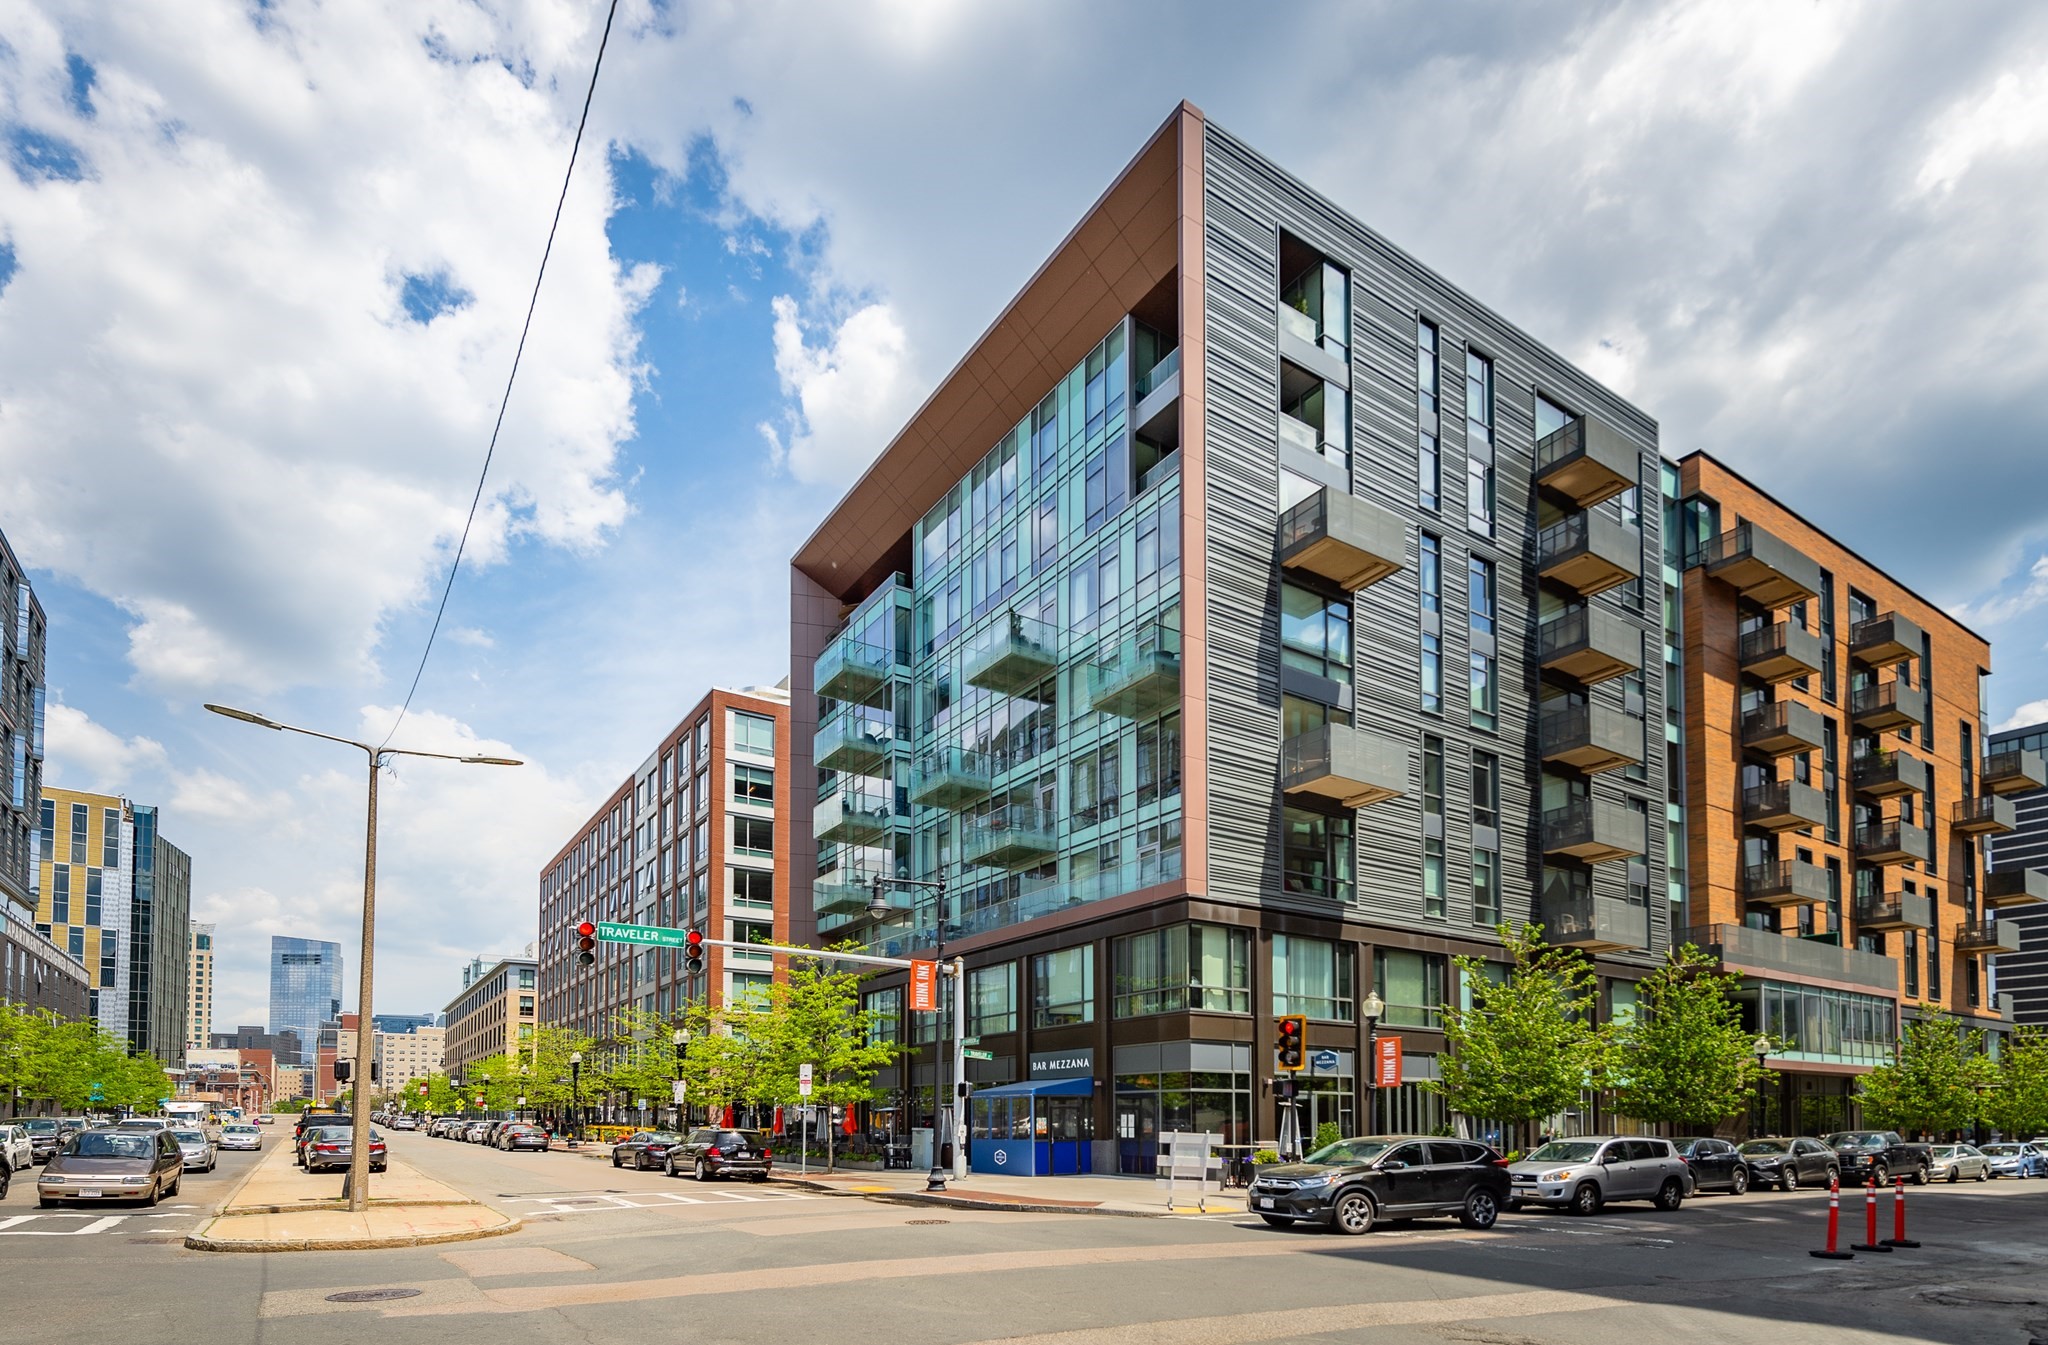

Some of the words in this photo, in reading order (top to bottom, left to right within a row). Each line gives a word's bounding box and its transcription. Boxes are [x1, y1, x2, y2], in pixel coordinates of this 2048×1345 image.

[6, 919, 43, 956] APARTMENTS
[600, 926, 659, 942] TRAVELER
[662, 936, 683, 944] STREET
[917, 964, 930, 980] INK
[916, 982, 929, 1008] THINK
[1383, 1041, 1396, 1057] INK
[1032, 1061, 1047, 1071] BAR
[1049, 1057, 1090, 1070] MEZZANA
[1383, 1058, 1396, 1085] THINK
